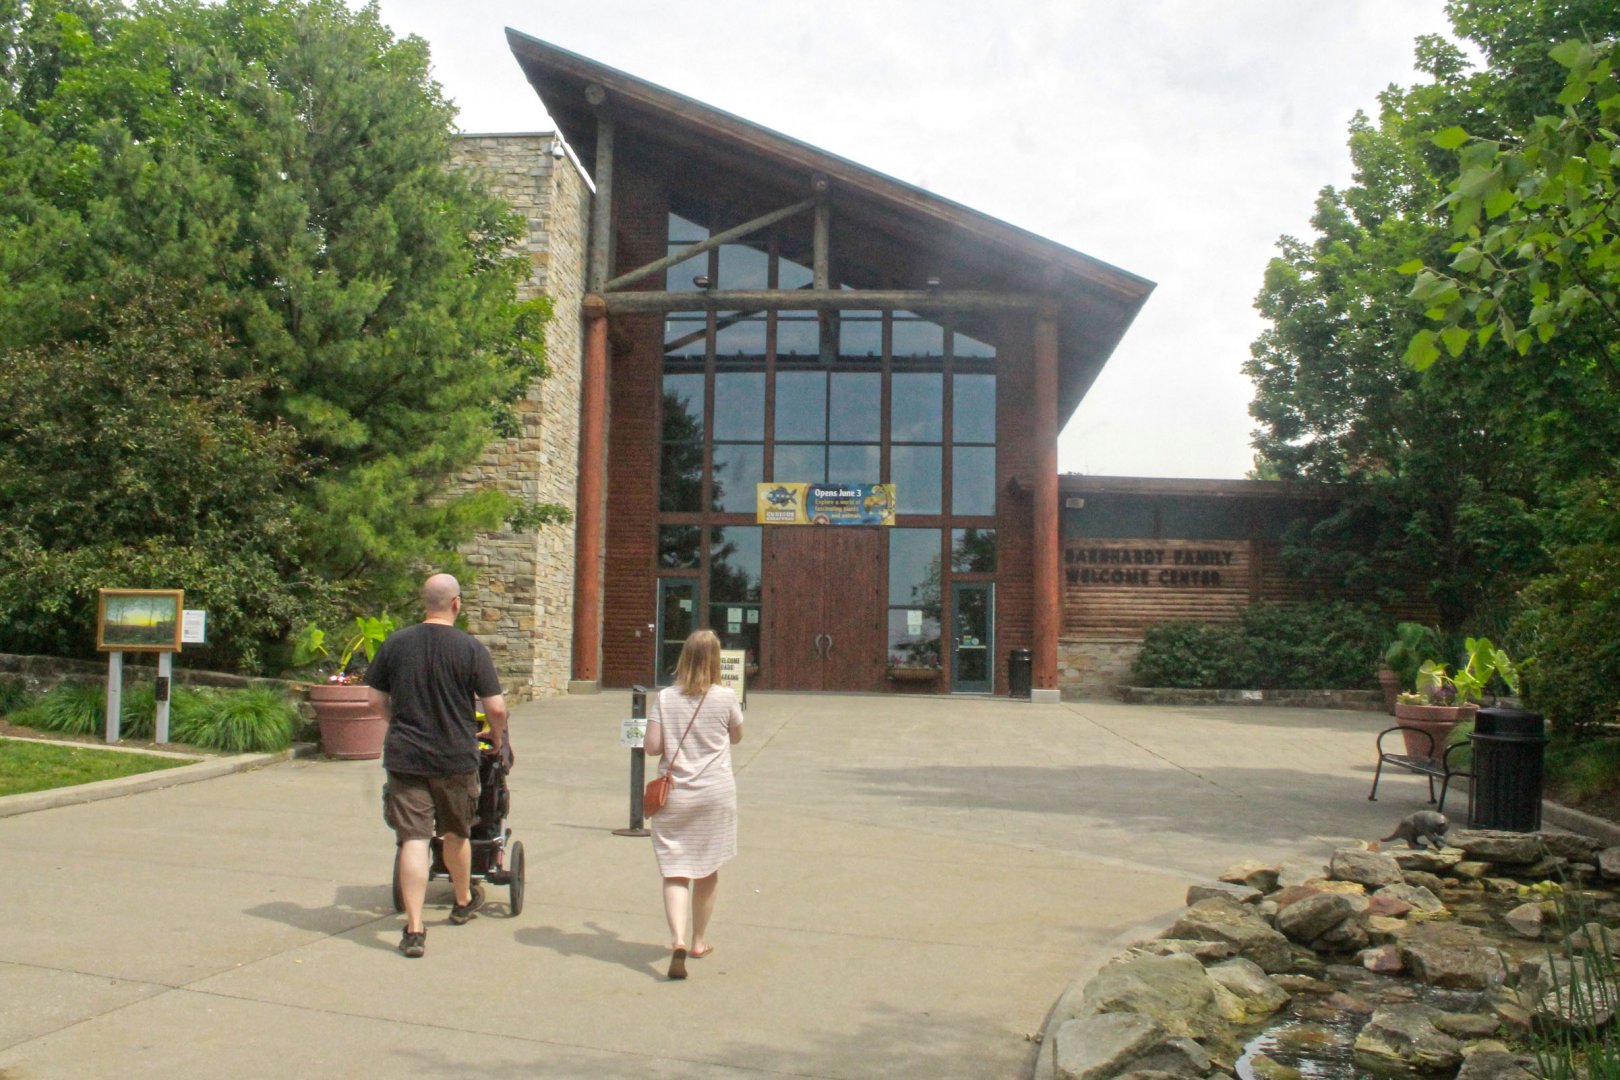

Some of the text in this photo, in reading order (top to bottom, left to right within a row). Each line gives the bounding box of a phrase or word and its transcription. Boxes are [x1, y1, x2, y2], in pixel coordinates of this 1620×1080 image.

[815, 489, 862, 498] Opens June 3
[1174, 550, 1233, 565] FAMILY
[1066, 568, 1221, 585] WELCOME CENTER
